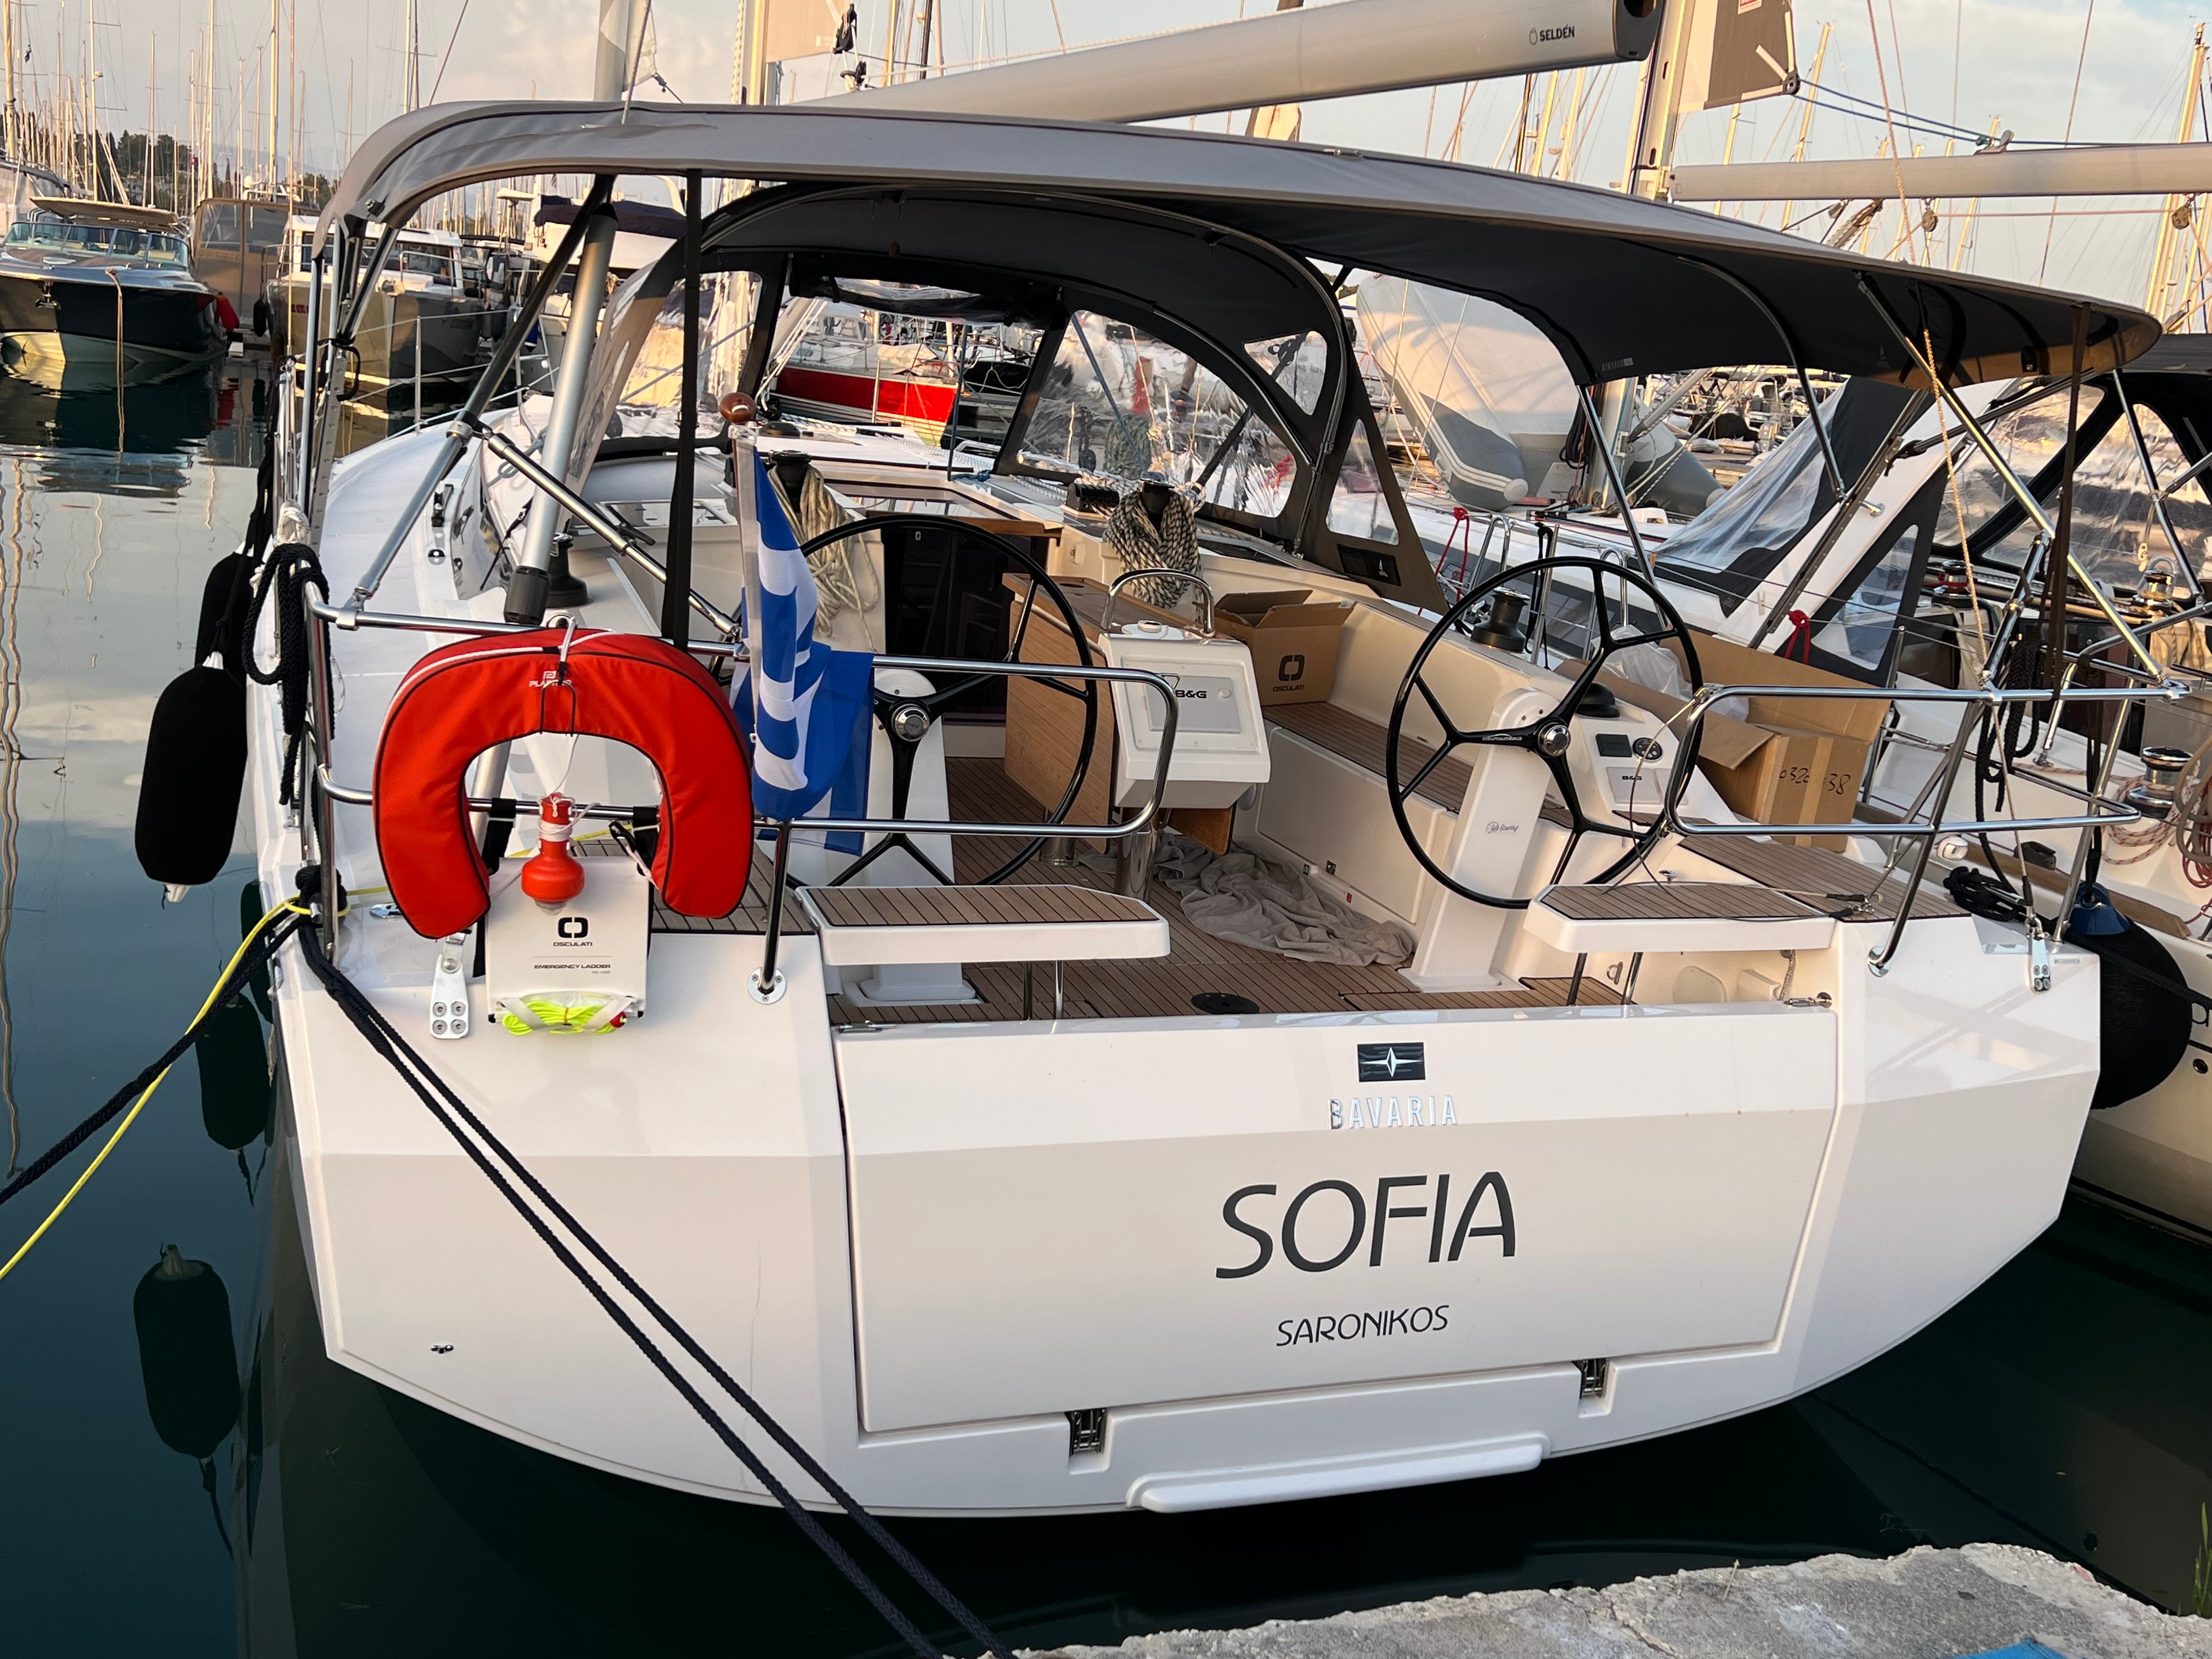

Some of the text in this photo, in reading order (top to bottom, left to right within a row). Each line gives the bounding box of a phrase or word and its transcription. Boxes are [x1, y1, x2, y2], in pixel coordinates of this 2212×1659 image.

[1539, 24, 1575, 42] SELDÉN
[1175, 690, 1207, 698] B&G
[1328, 1094, 1457, 1130] BAVARIA
[1216, 1171, 1515, 1278] SOFIA
[1276, 1305, 1449, 1346] SARONIKOS
